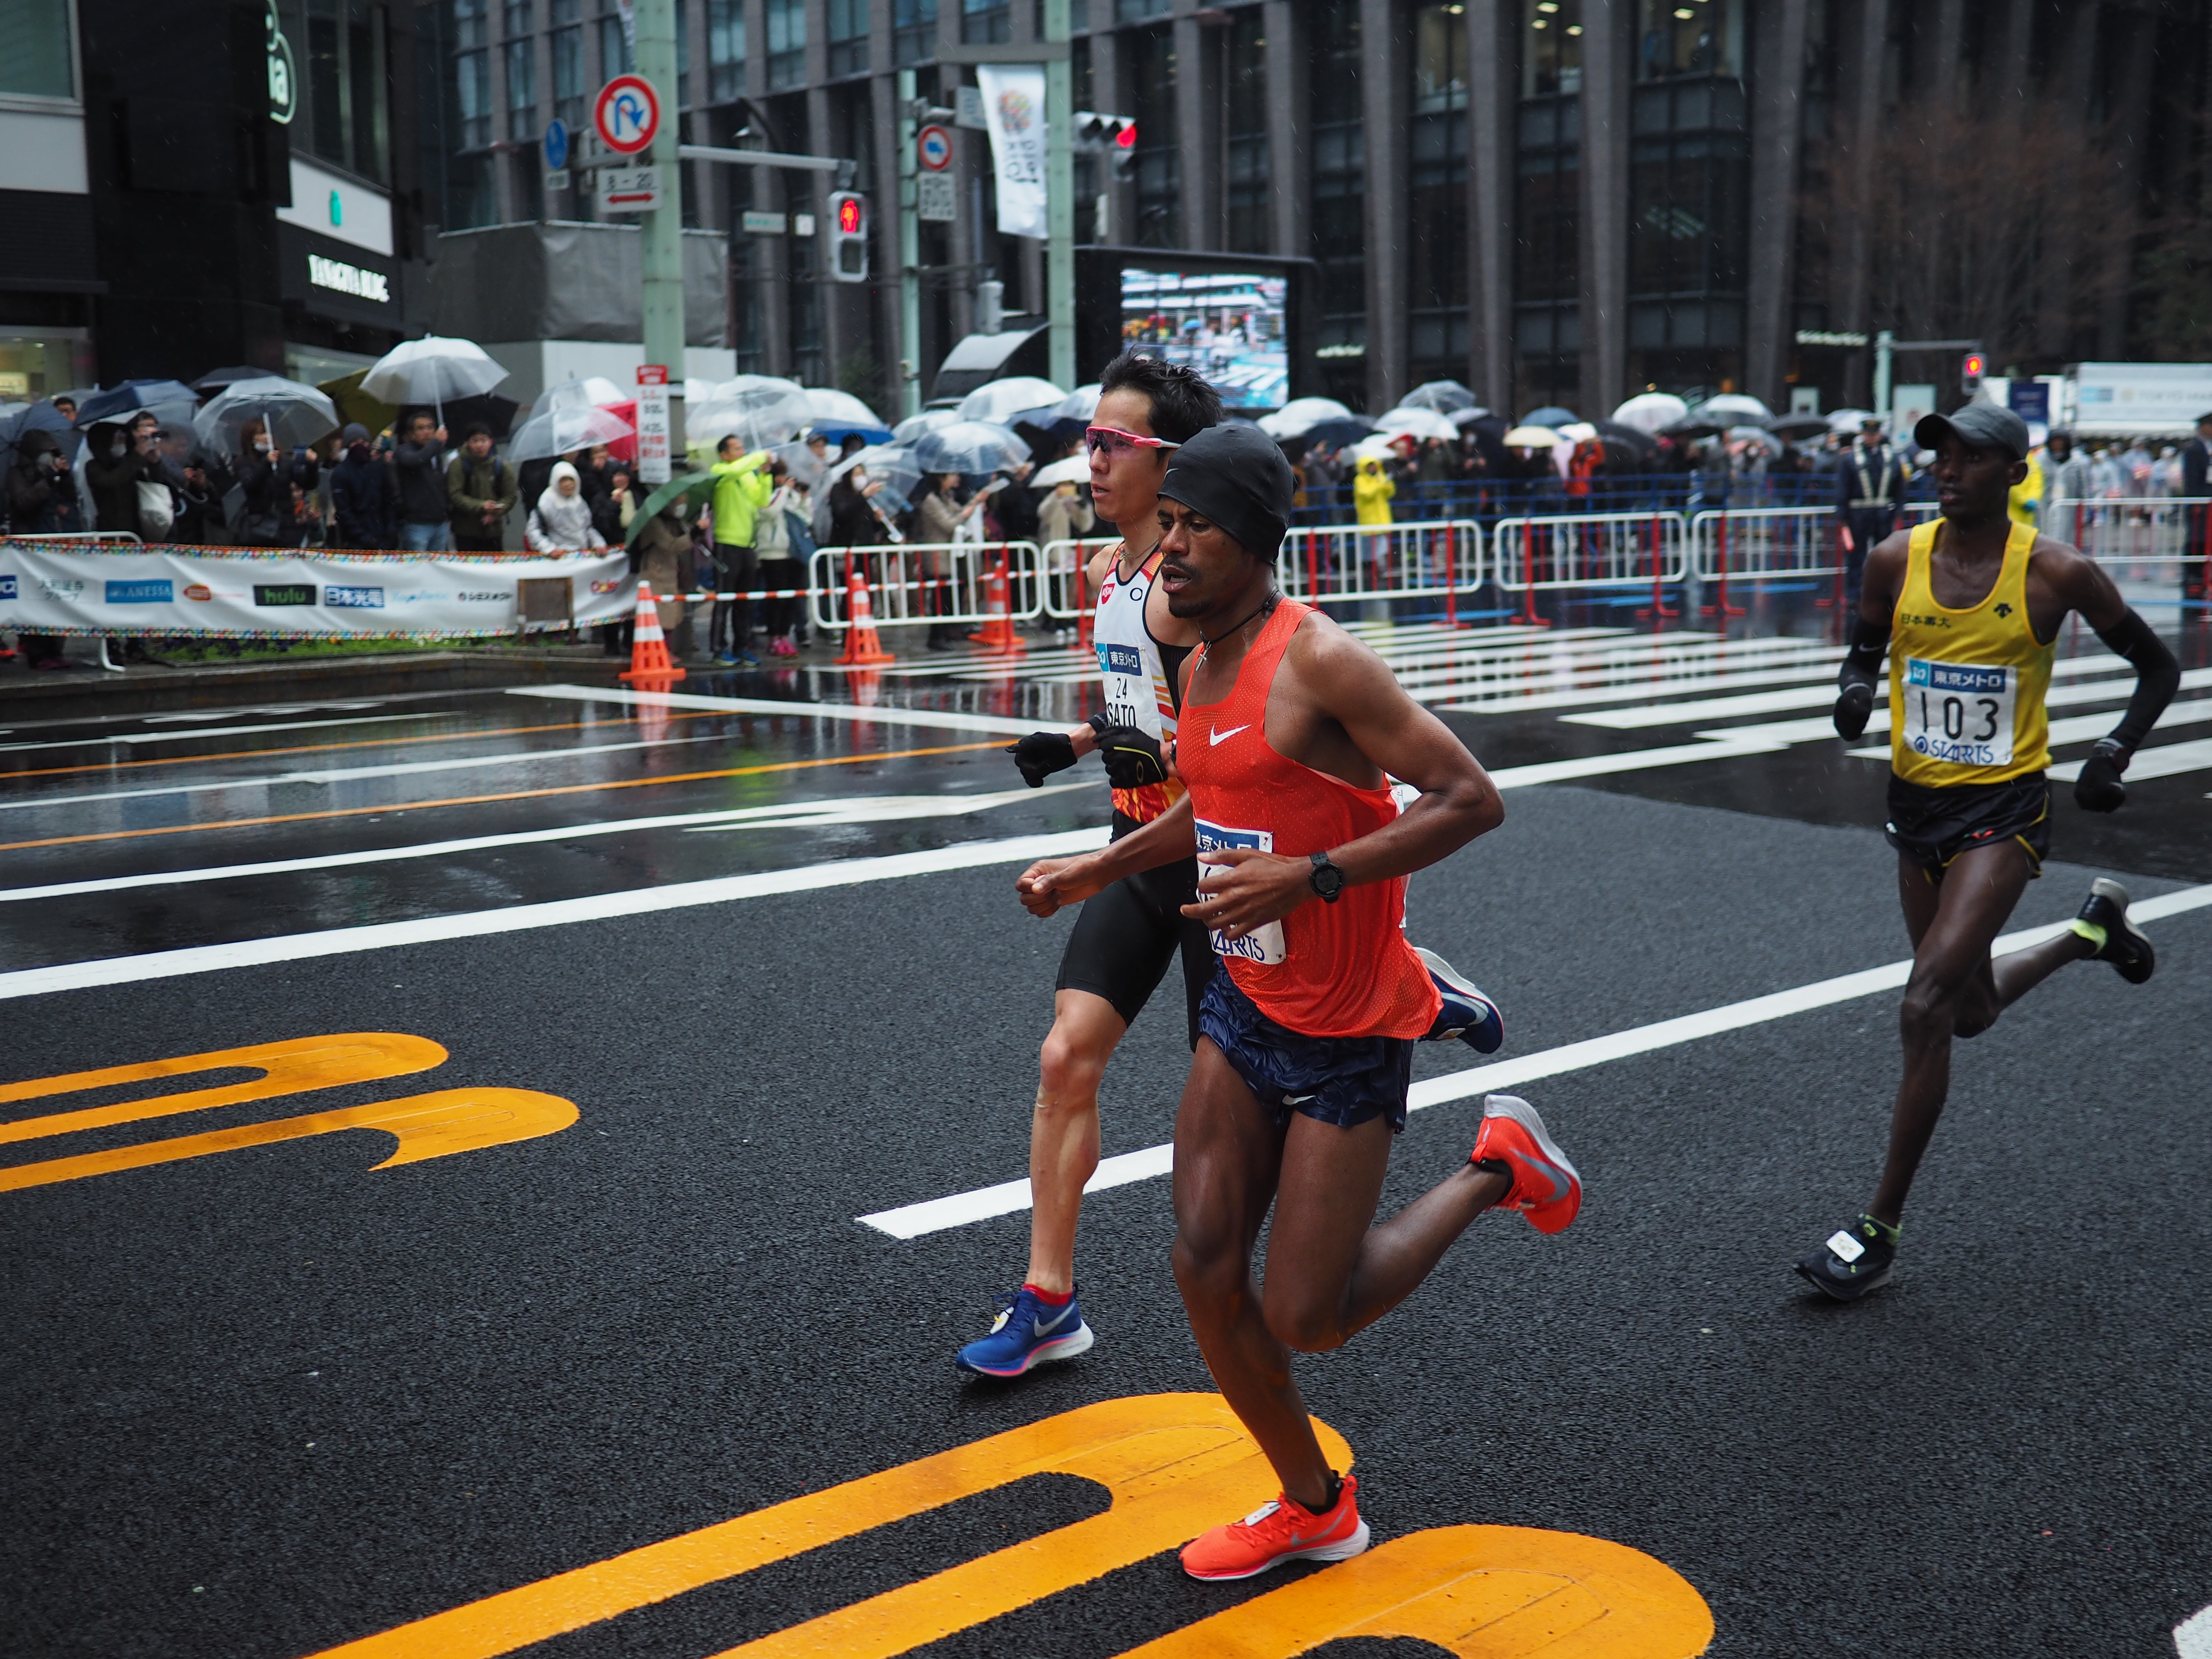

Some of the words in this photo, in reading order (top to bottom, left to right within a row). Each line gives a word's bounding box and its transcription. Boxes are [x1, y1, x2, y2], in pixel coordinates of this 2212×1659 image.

[264, 587, 306, 603] hulu
[1901, 613, 1951, 628] 日本薬大
[1110, 651, 1138, 668] 東京メトロ
[1933, 670, 2002, 687] 東京メトロ
[1116, 677, 1127, 699] 24
[1107, 702, 1136, 727] SATO
[1921, 691, 1999, 742] 103
